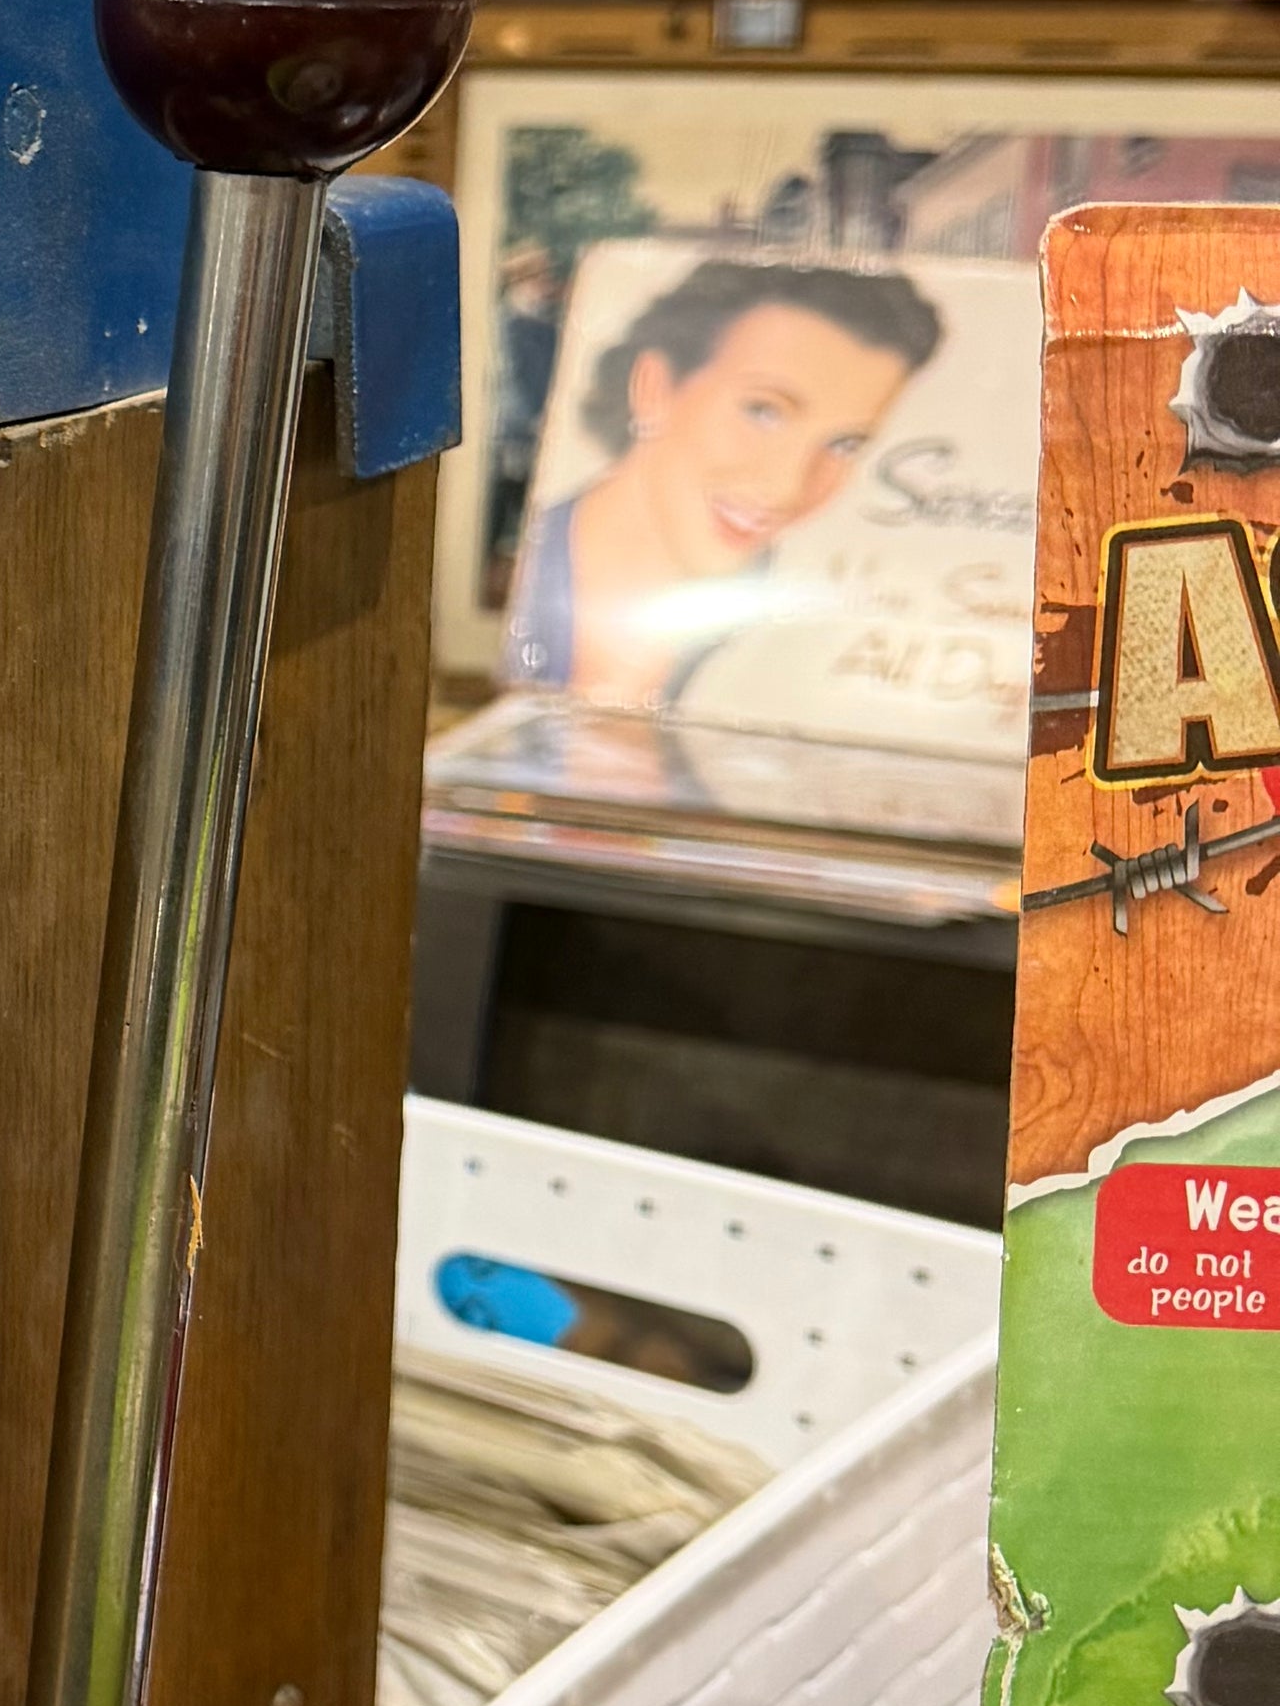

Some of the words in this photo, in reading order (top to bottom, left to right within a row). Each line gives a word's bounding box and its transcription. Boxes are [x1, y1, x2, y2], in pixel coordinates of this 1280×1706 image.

[1127, 1245, 1169, 1276] do
[1196, 1249, 1252, 1279] not
[1151, 1284, 1266, 1320] people
